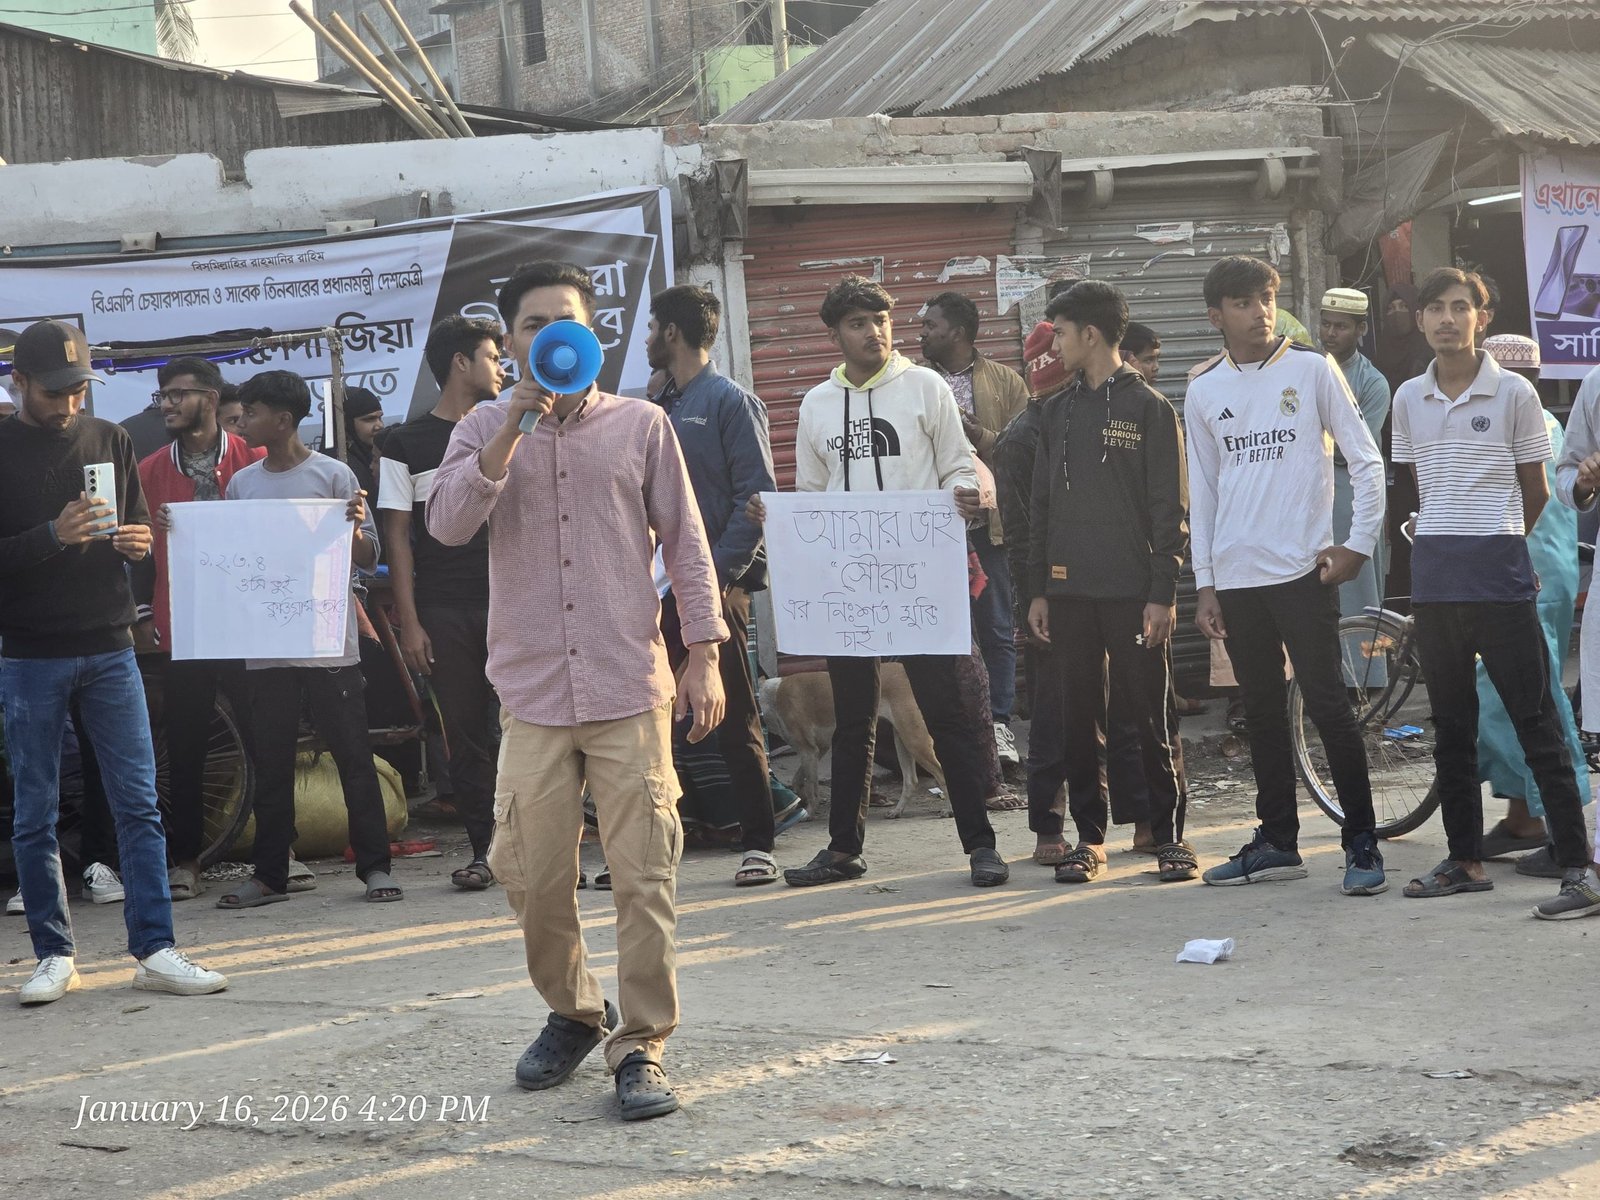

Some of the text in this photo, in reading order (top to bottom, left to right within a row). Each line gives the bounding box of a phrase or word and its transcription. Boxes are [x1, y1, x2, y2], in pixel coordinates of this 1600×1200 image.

[91, 263, 423, 314] বিএনপি চেয়ারপারসন ও সাবেক তিনবারের প্রধানমন্ত্রী দেশনেত্রী
[1102, 428, 1142, 441] GLORIOUS
[1110, 420, 1137, 431] HIGH
[1223, 428, 1296, 452] Emirates
[1249, 446, 1284, 463] BETTER
[792, 498, 961, 551] আমার ভাই
[783, 599, 812, 620] এর
